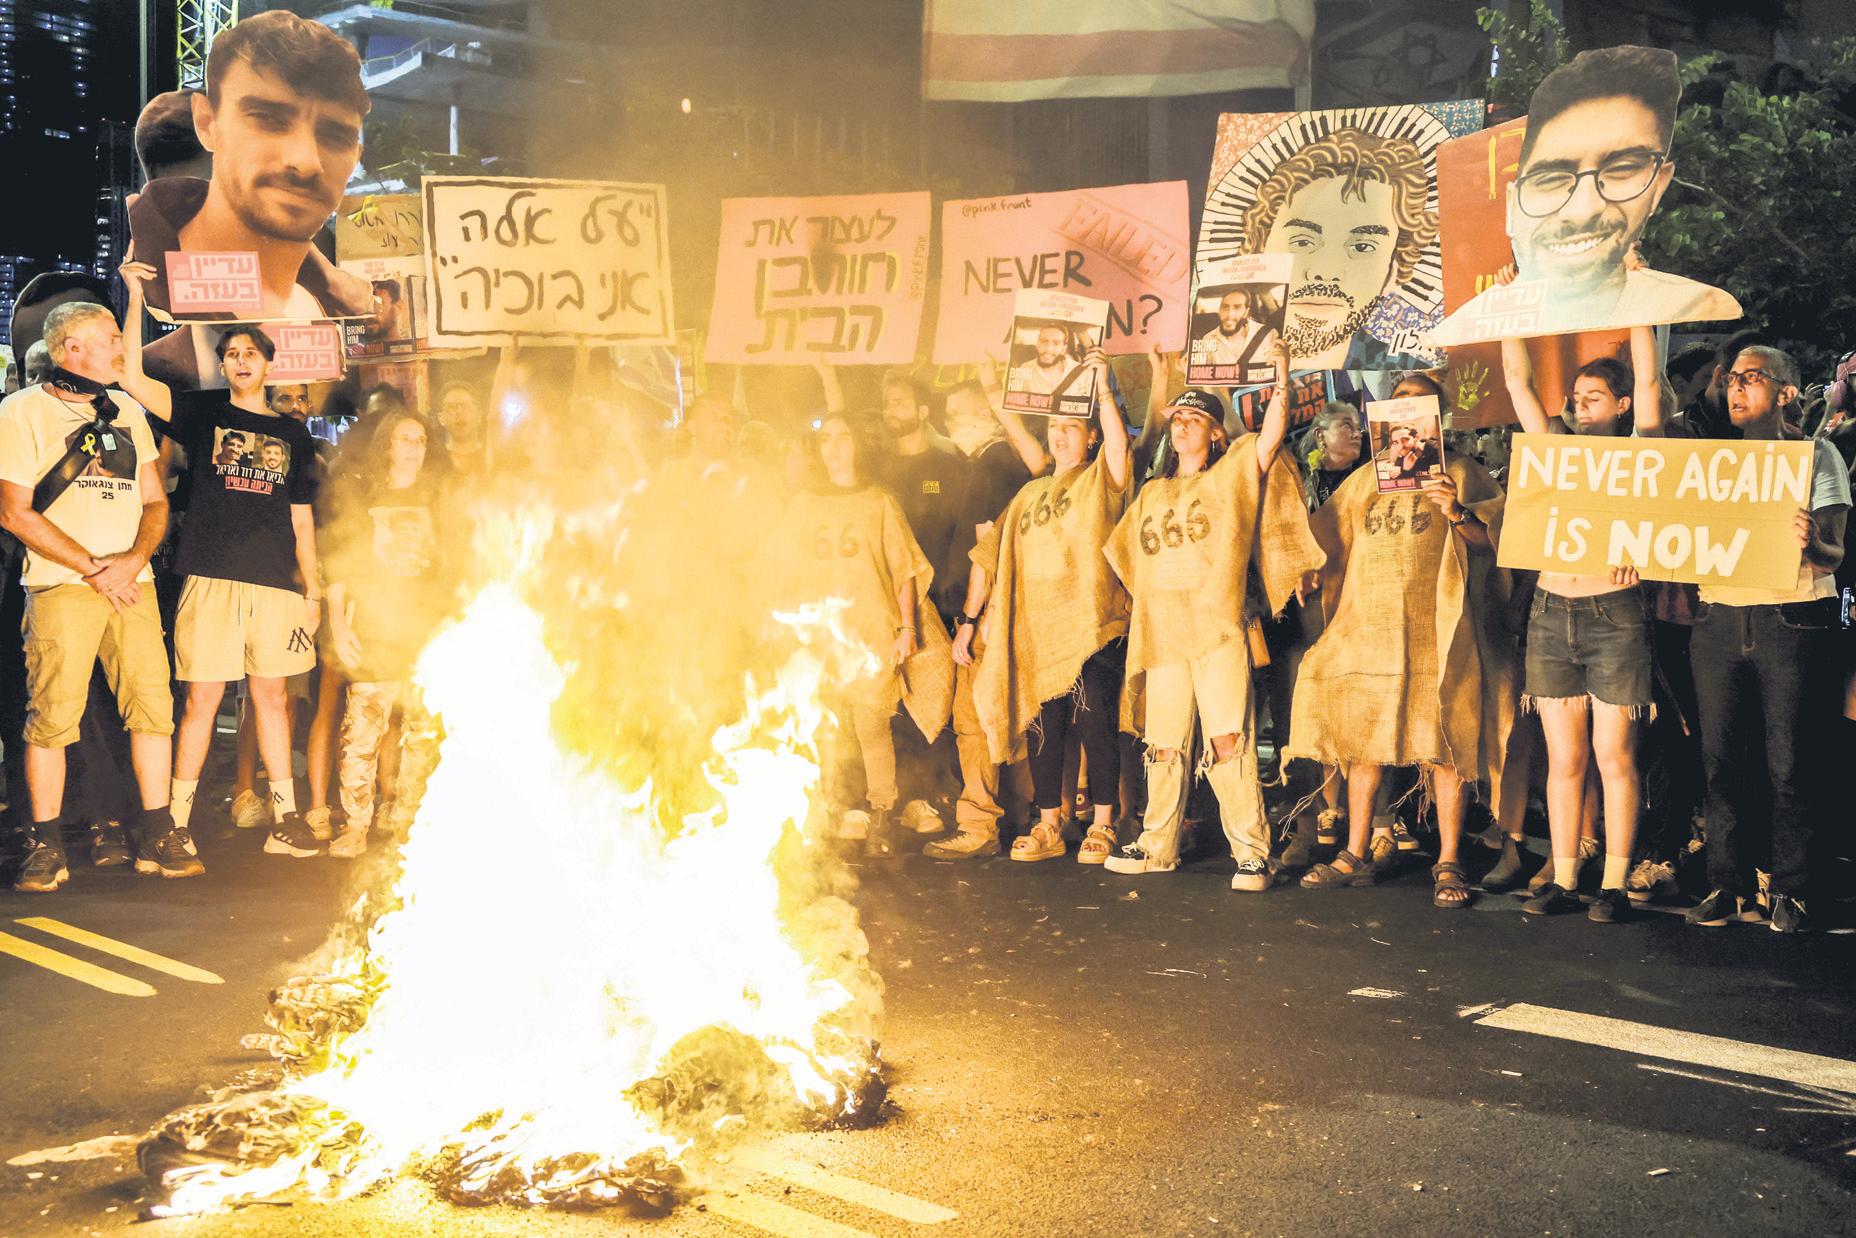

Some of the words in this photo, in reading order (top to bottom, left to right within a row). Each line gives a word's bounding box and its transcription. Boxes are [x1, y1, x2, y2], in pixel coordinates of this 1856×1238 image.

[459, 190, 557, 247] אלה
[745, 214, 799, 247] את
[1060, 201, 1188, 283] FAILED
[194, 256, 254, 277] עדיין
[963, 250, 1092, 296] NEVER
[184, 282, 258, 300] בעזה.
[597, 268, 650, 321] אני
[283, 330, 332, 348] עדיין
[745, 304, 885, 353] הבית
[1191, 339, 1217, 352] BRING
[1189, 365, 1214, 379] HOME
[1215, 364, 1239, 379] NOW!
[253, 469, 265, 481] את
[1519, 446, 1665, 498] NEVER
[101, 491, 115, 500] 25
[1020, 487, 1071, 536] 666
[1365, 494, 1432, 535] 666
[1140, 497, 1211, 555] 666
[1607, 519, 1750, 577] NOW
